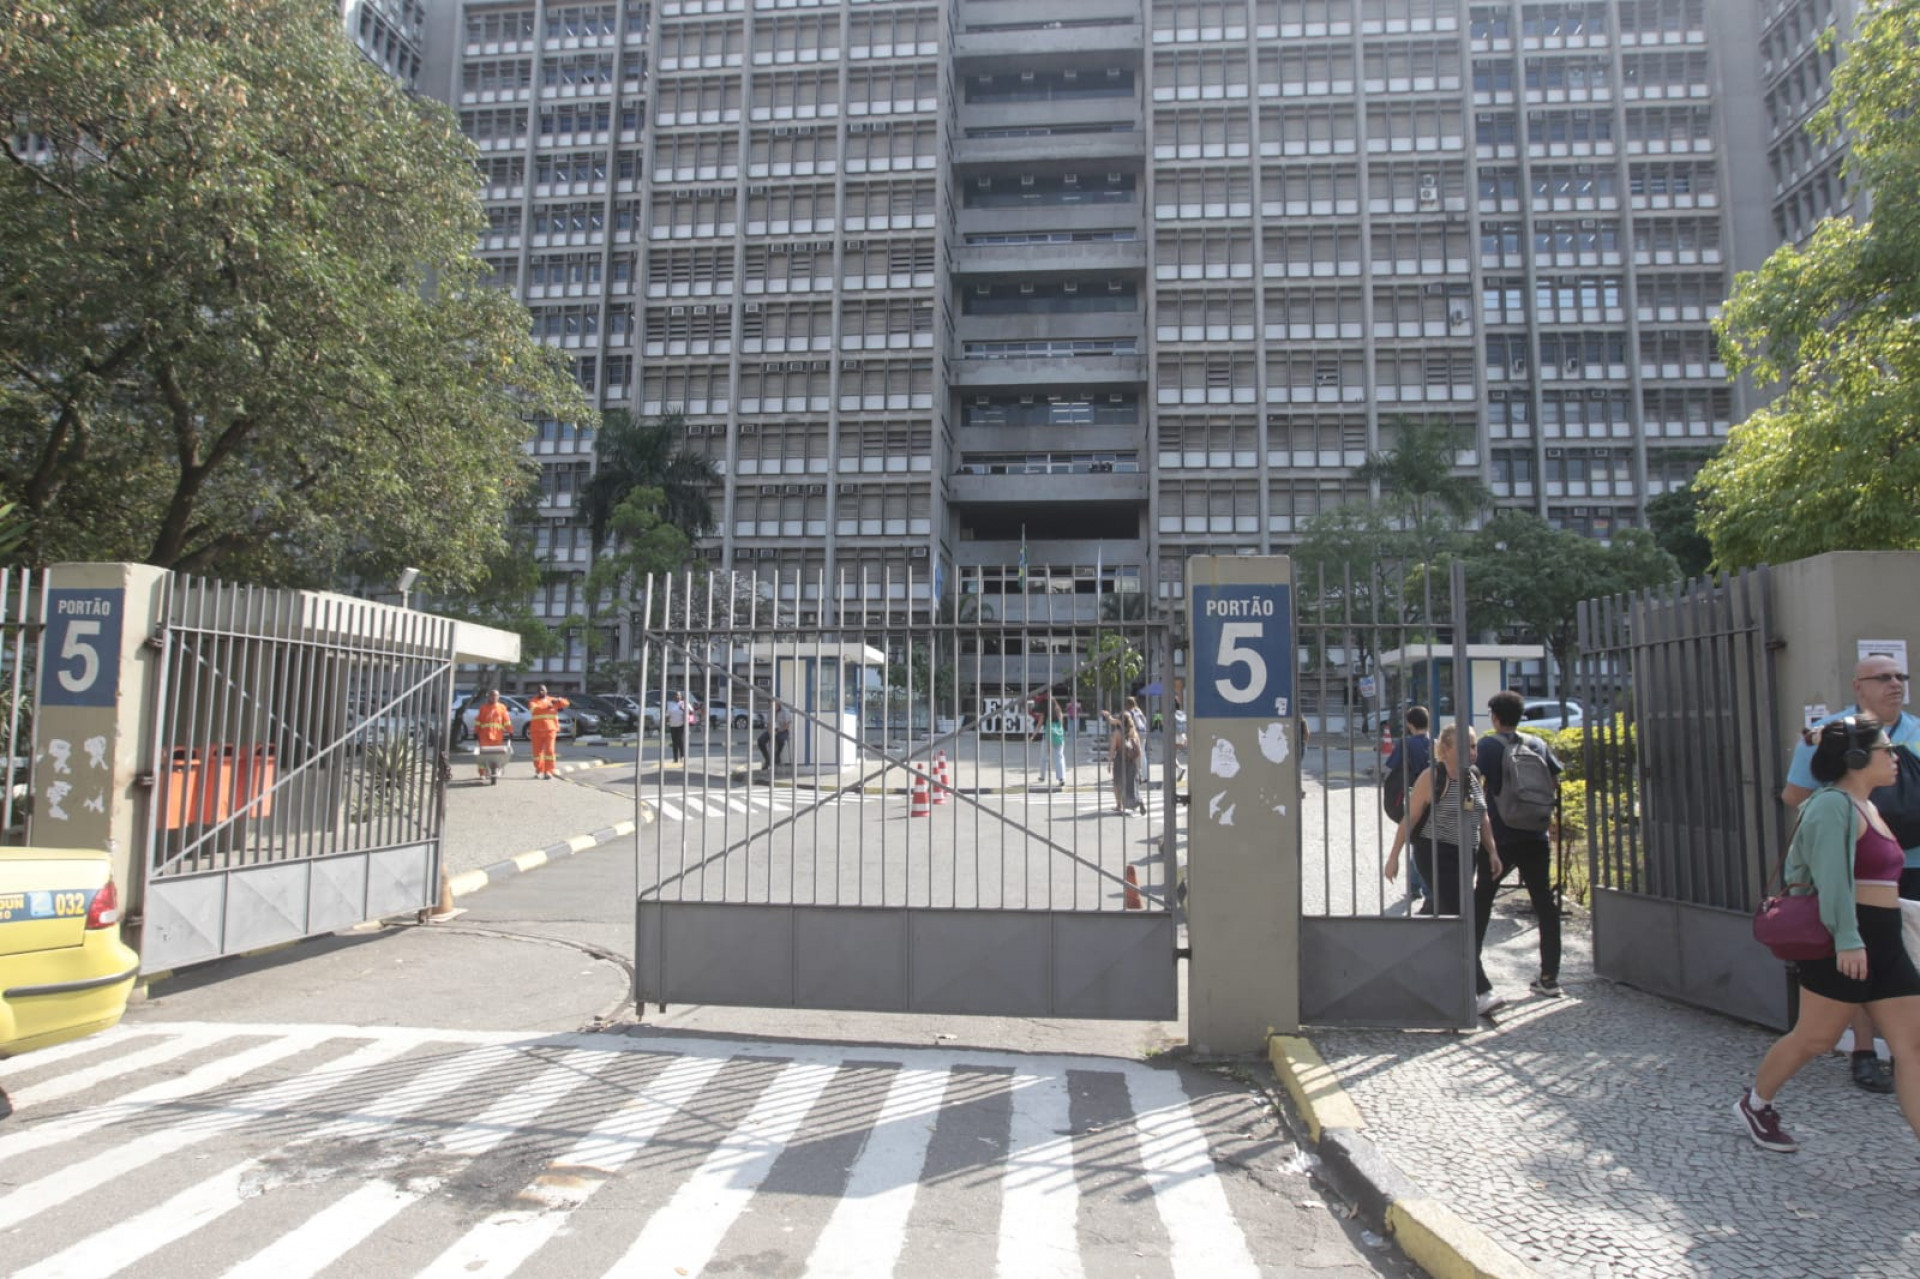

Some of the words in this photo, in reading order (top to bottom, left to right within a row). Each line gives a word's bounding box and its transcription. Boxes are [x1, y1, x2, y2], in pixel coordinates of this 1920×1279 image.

[58, 597, 111, 617] PORTÃO
[1206, 595, 1274, 617] PORTÃO
[58, 620, 100, 692] 5
[1215, 622, 1267, 704] 5
[55, 892, 85, 916] 032
